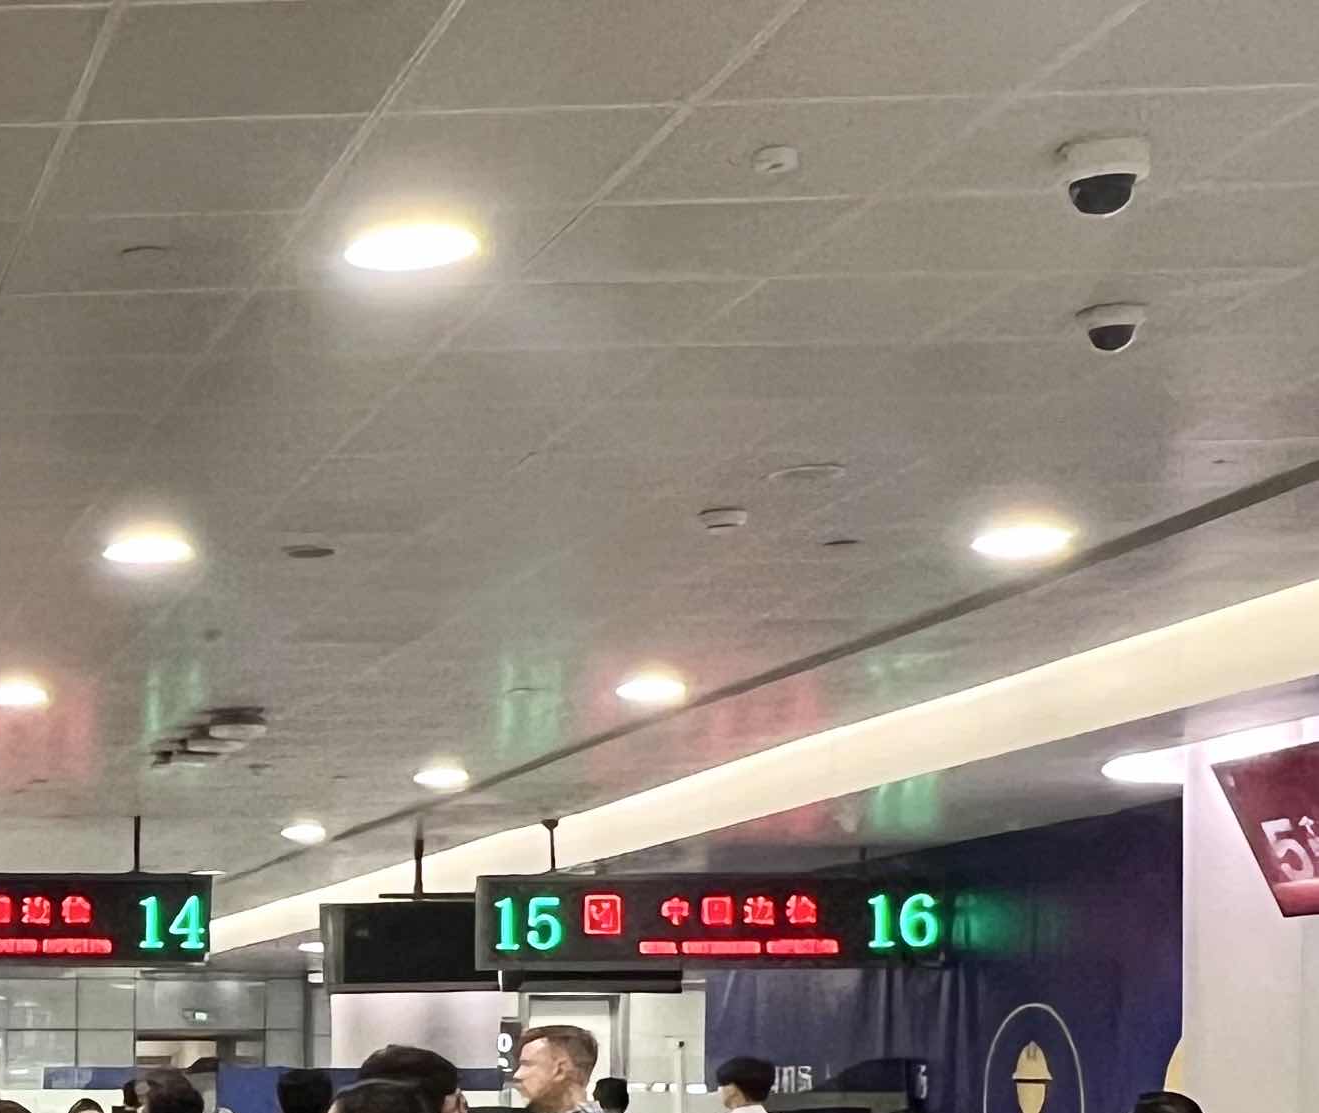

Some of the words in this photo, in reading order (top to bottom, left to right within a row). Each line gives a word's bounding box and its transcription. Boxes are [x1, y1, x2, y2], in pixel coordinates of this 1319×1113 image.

[138, 895, 206, 950] 14
[493, 896, 563, 951] 15
[868, 893, 941, 949] 16
